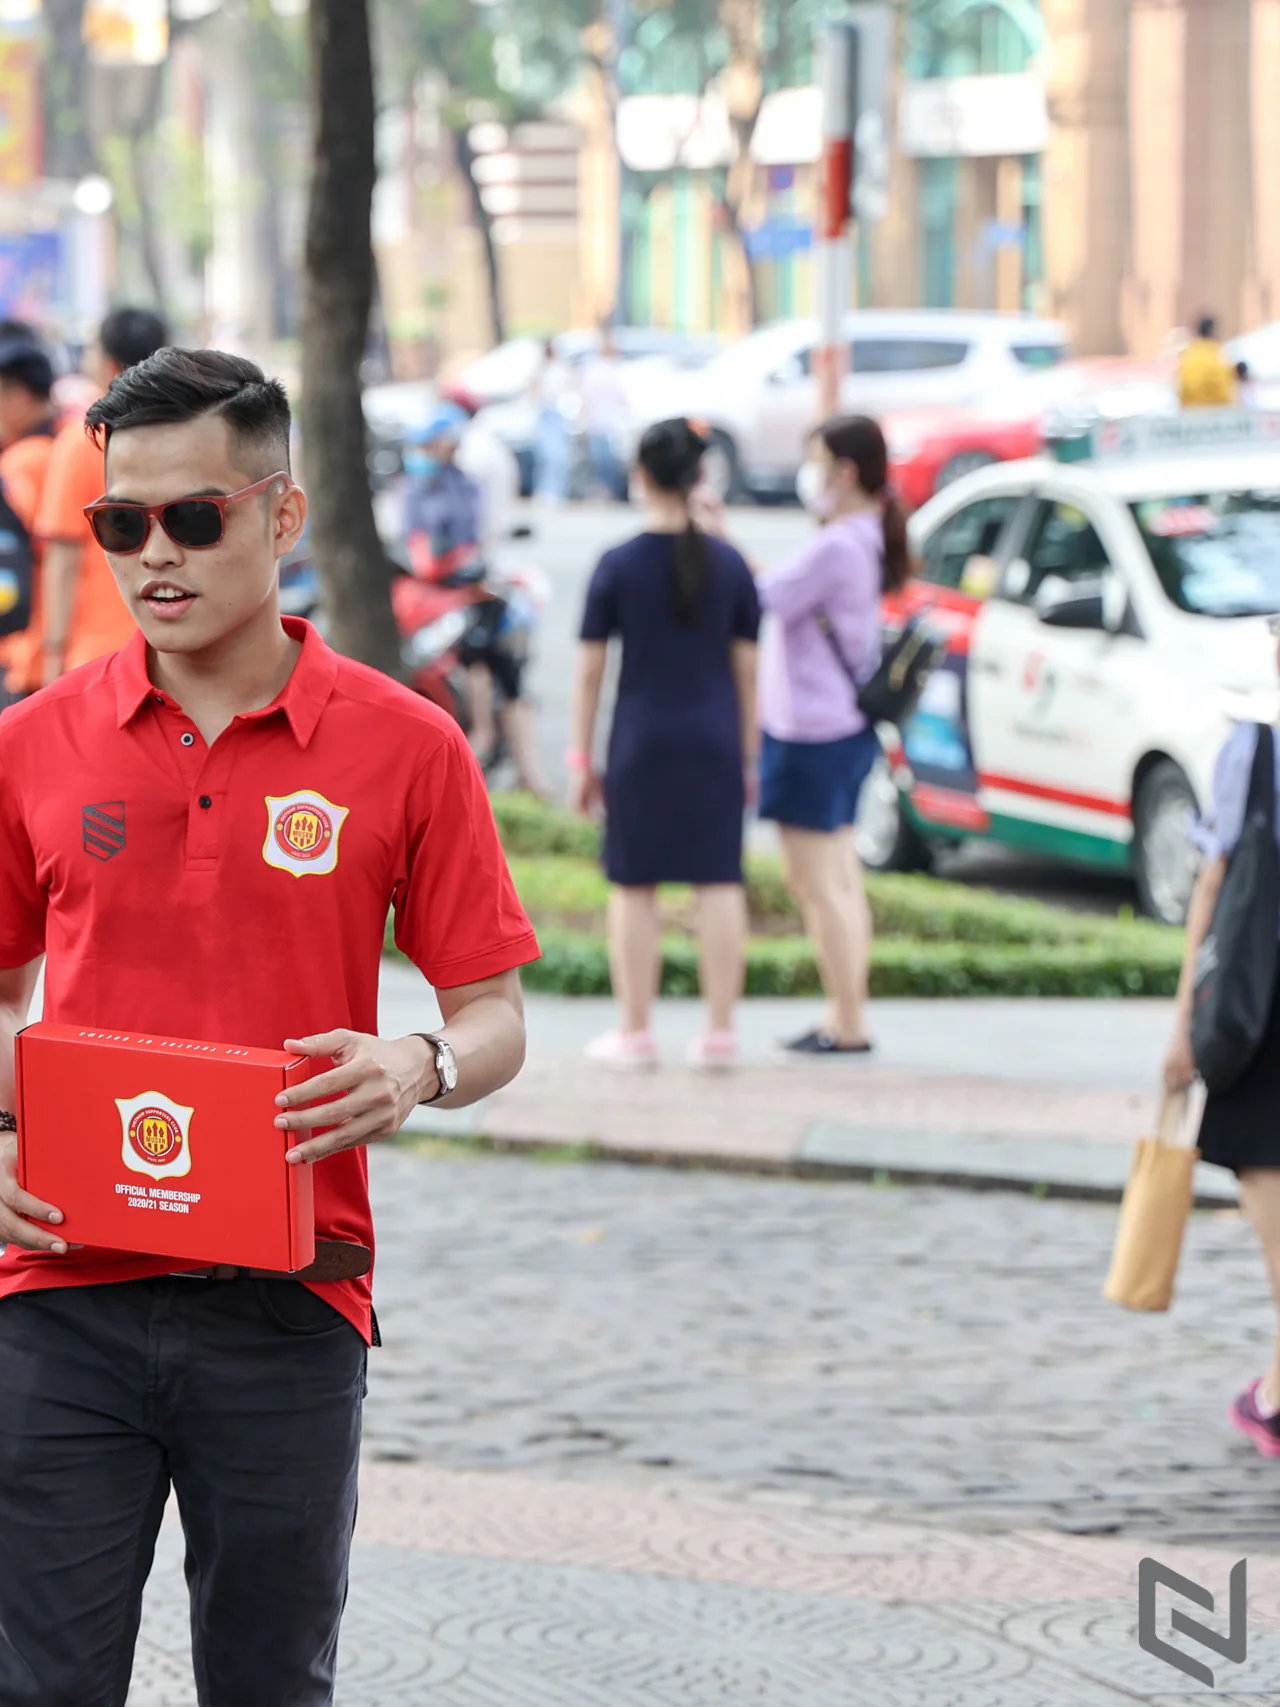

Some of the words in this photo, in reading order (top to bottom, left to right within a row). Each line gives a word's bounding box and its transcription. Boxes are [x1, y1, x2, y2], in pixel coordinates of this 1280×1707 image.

[131, 1111, 145, 1128] VIETNAM
[145, 1108, 172, 1122] SUPPORTERS
[115, 1184, 148, 1197] OFFICIAL
[149, 1188, 201, 1203] MEMBERSHIP
[127, 1197, 157, 1210] 2020/21
[159, 1200, 190, 1214] SEASON
